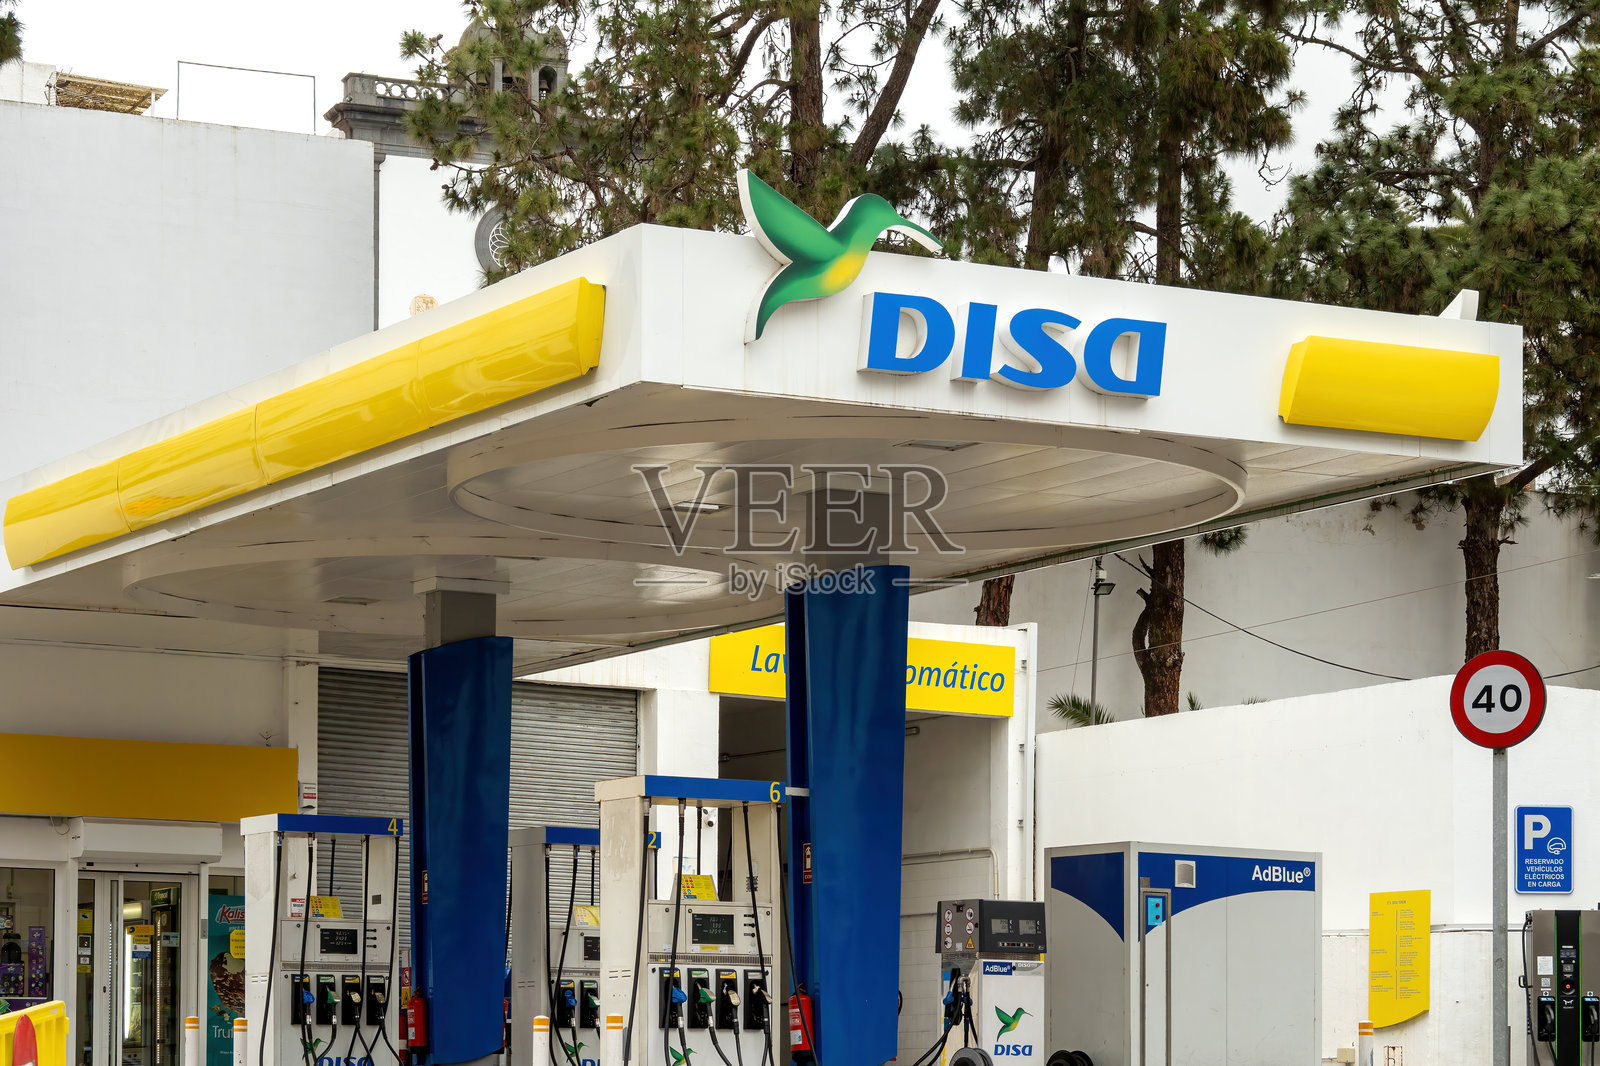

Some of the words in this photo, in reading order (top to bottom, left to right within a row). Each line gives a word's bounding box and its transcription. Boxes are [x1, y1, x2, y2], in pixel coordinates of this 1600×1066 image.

[1471, 684, 1522, 713] 40
[769, 781, 781, 802] 6
[387, 817, 399, 836] 4
[1524, 814, 1551, 850] P
[647, 831, 657, 848] 2
[1526, 865, 1563, 873] VEHÍCULOS
